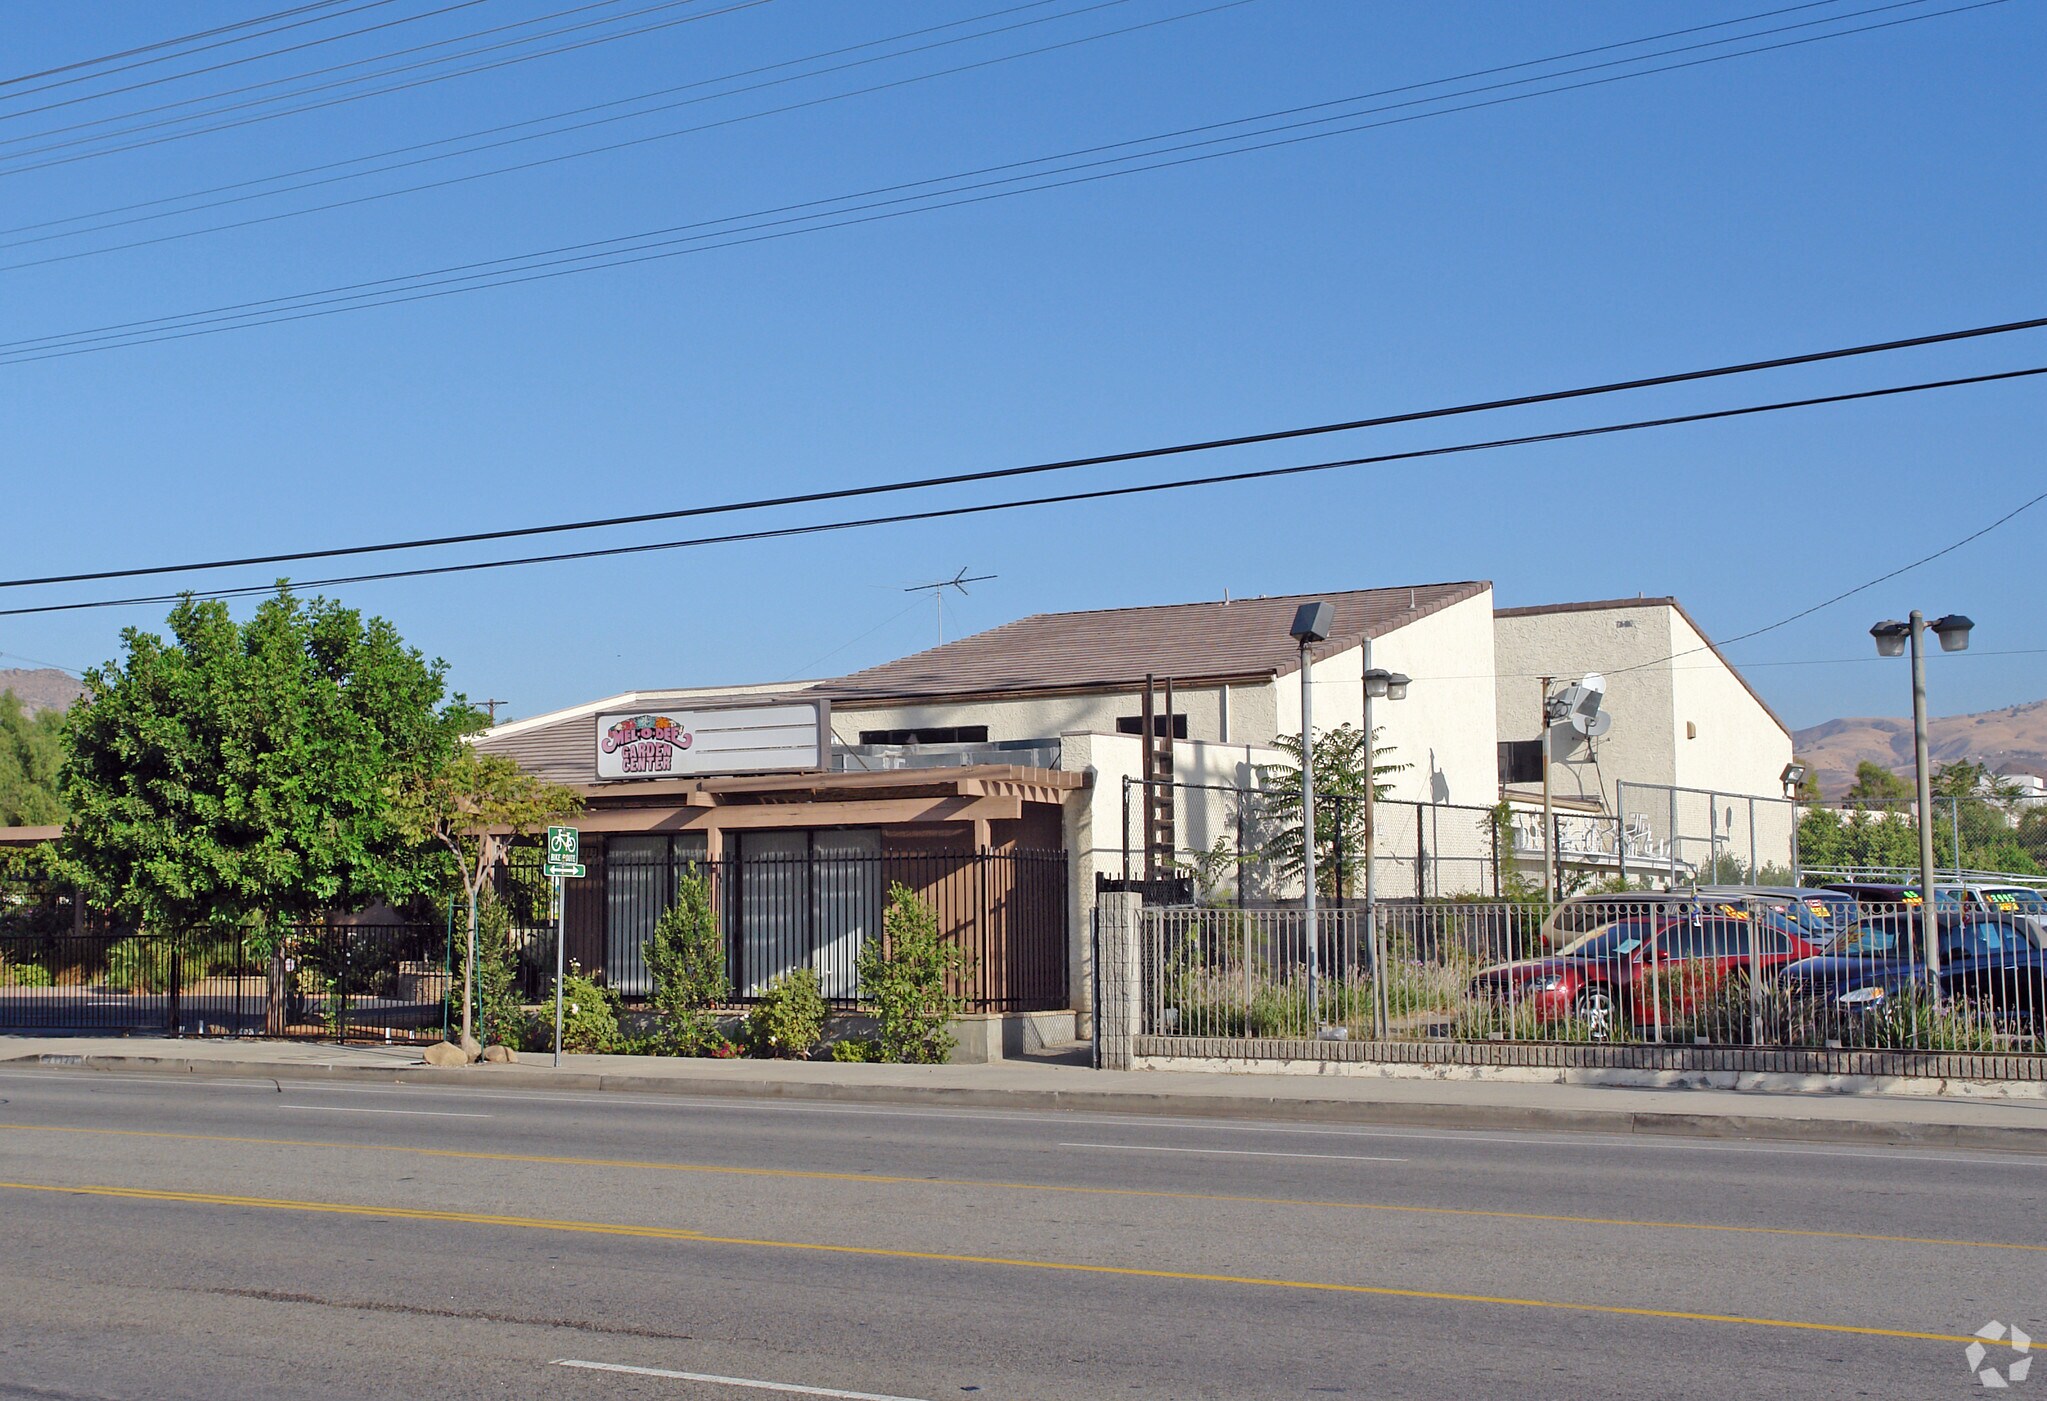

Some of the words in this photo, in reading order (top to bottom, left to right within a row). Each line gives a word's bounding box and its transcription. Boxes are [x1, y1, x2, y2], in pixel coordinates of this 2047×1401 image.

[621, 742, 672, 758] GARDEN
[621, 757, 672, 772] CENTER
[550, 853, 562, 862] BIKE
[562, 854, 576, 863] ROUTE
